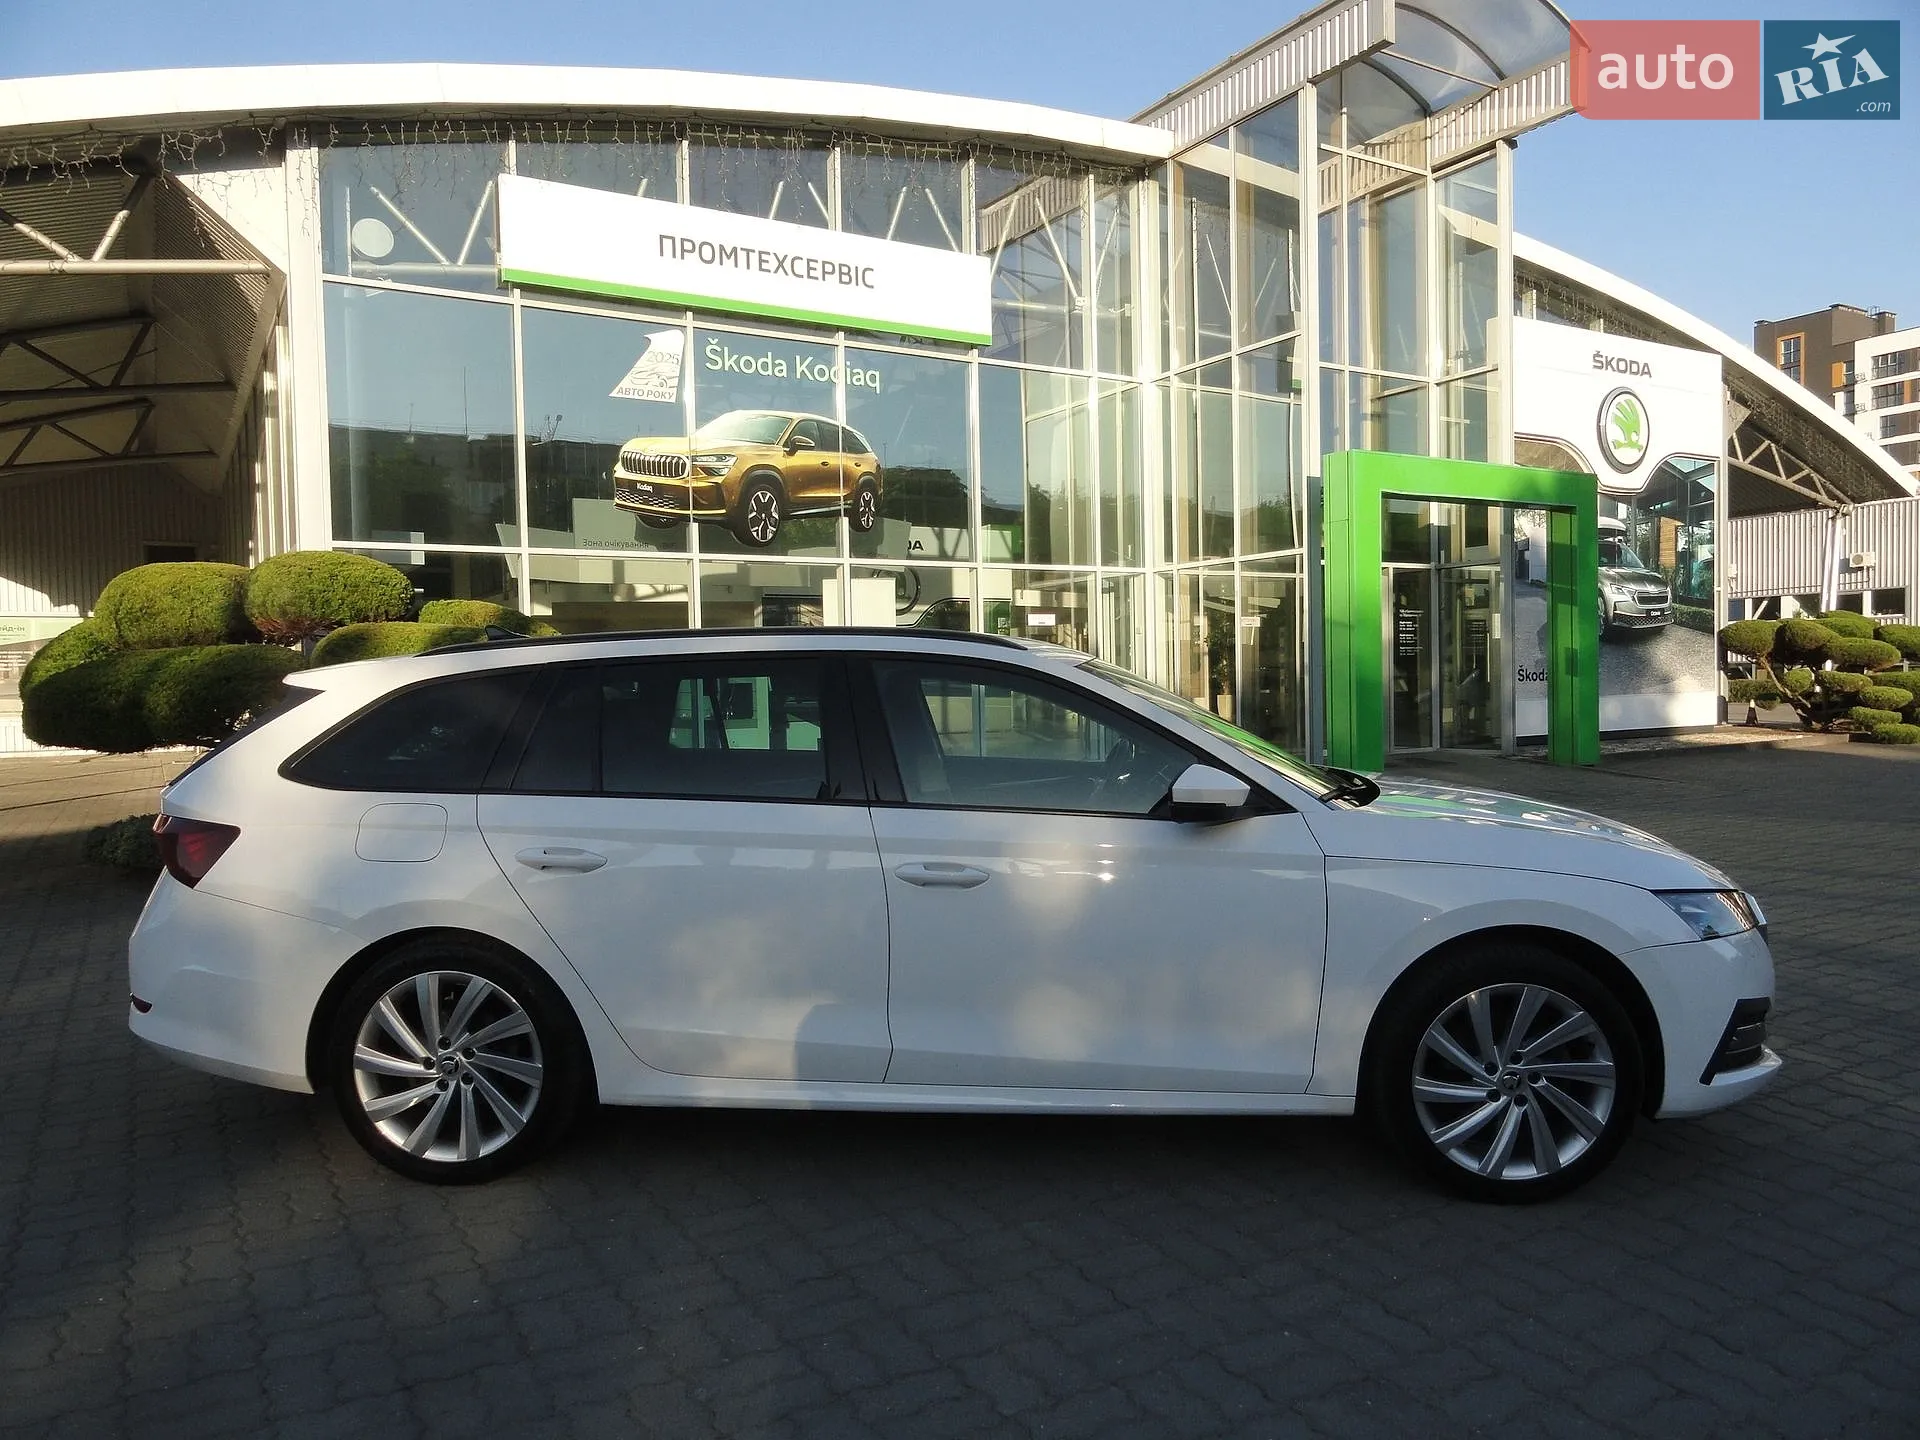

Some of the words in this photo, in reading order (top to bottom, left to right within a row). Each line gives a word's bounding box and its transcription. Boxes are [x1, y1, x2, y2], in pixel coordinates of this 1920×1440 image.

[659, 234, 875, 289] ПРОМТЕХСЕРВІС
[646, 350, 680, 365] 2025
[705, 337, 787, 378] Škoda
[1592, 350, 1652, 378] ŠKODA
[616, 386, 645, 397] АВТО
[646, 389, 675, 400] РОКУ
[583, 538, 602, 547] Зона
